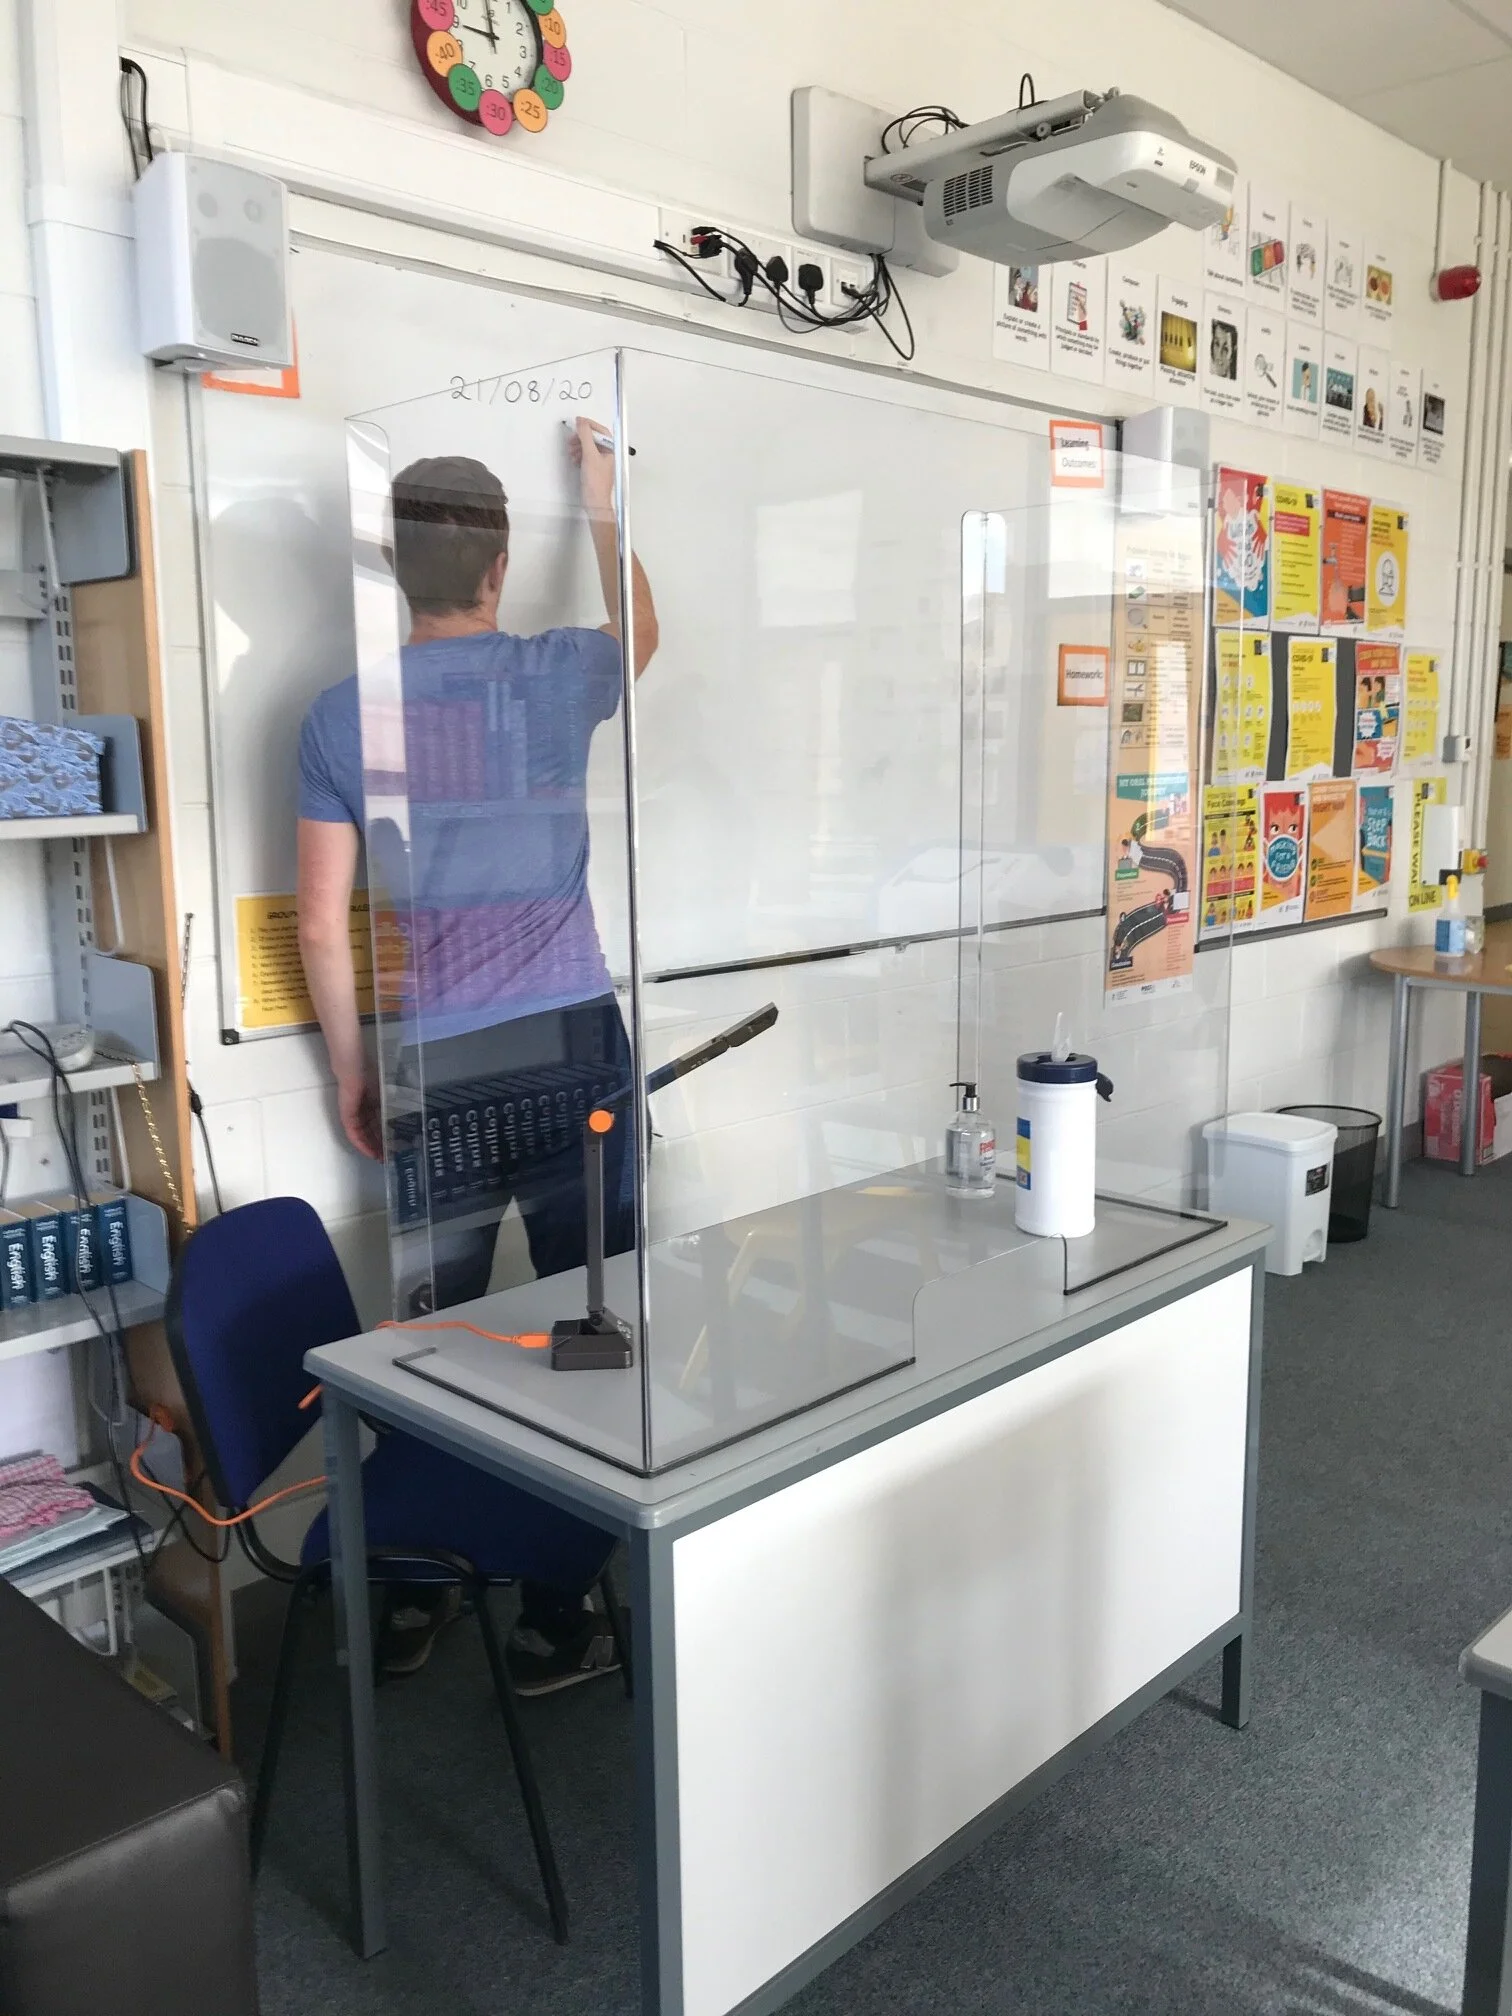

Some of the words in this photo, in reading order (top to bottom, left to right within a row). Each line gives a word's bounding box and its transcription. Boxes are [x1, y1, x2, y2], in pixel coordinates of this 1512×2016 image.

[516, 22, 524, 36] 2
[519, 45, 527, 59] 3
[514, 66, 521, 78] 4
[485, 75, 493, 87] 6
[502, 76, 510, 89] 5
[109, 1221, 126, 1266] English
[40, 1235, 60, 1281] English
[7, 1243, 27, 1290] English
